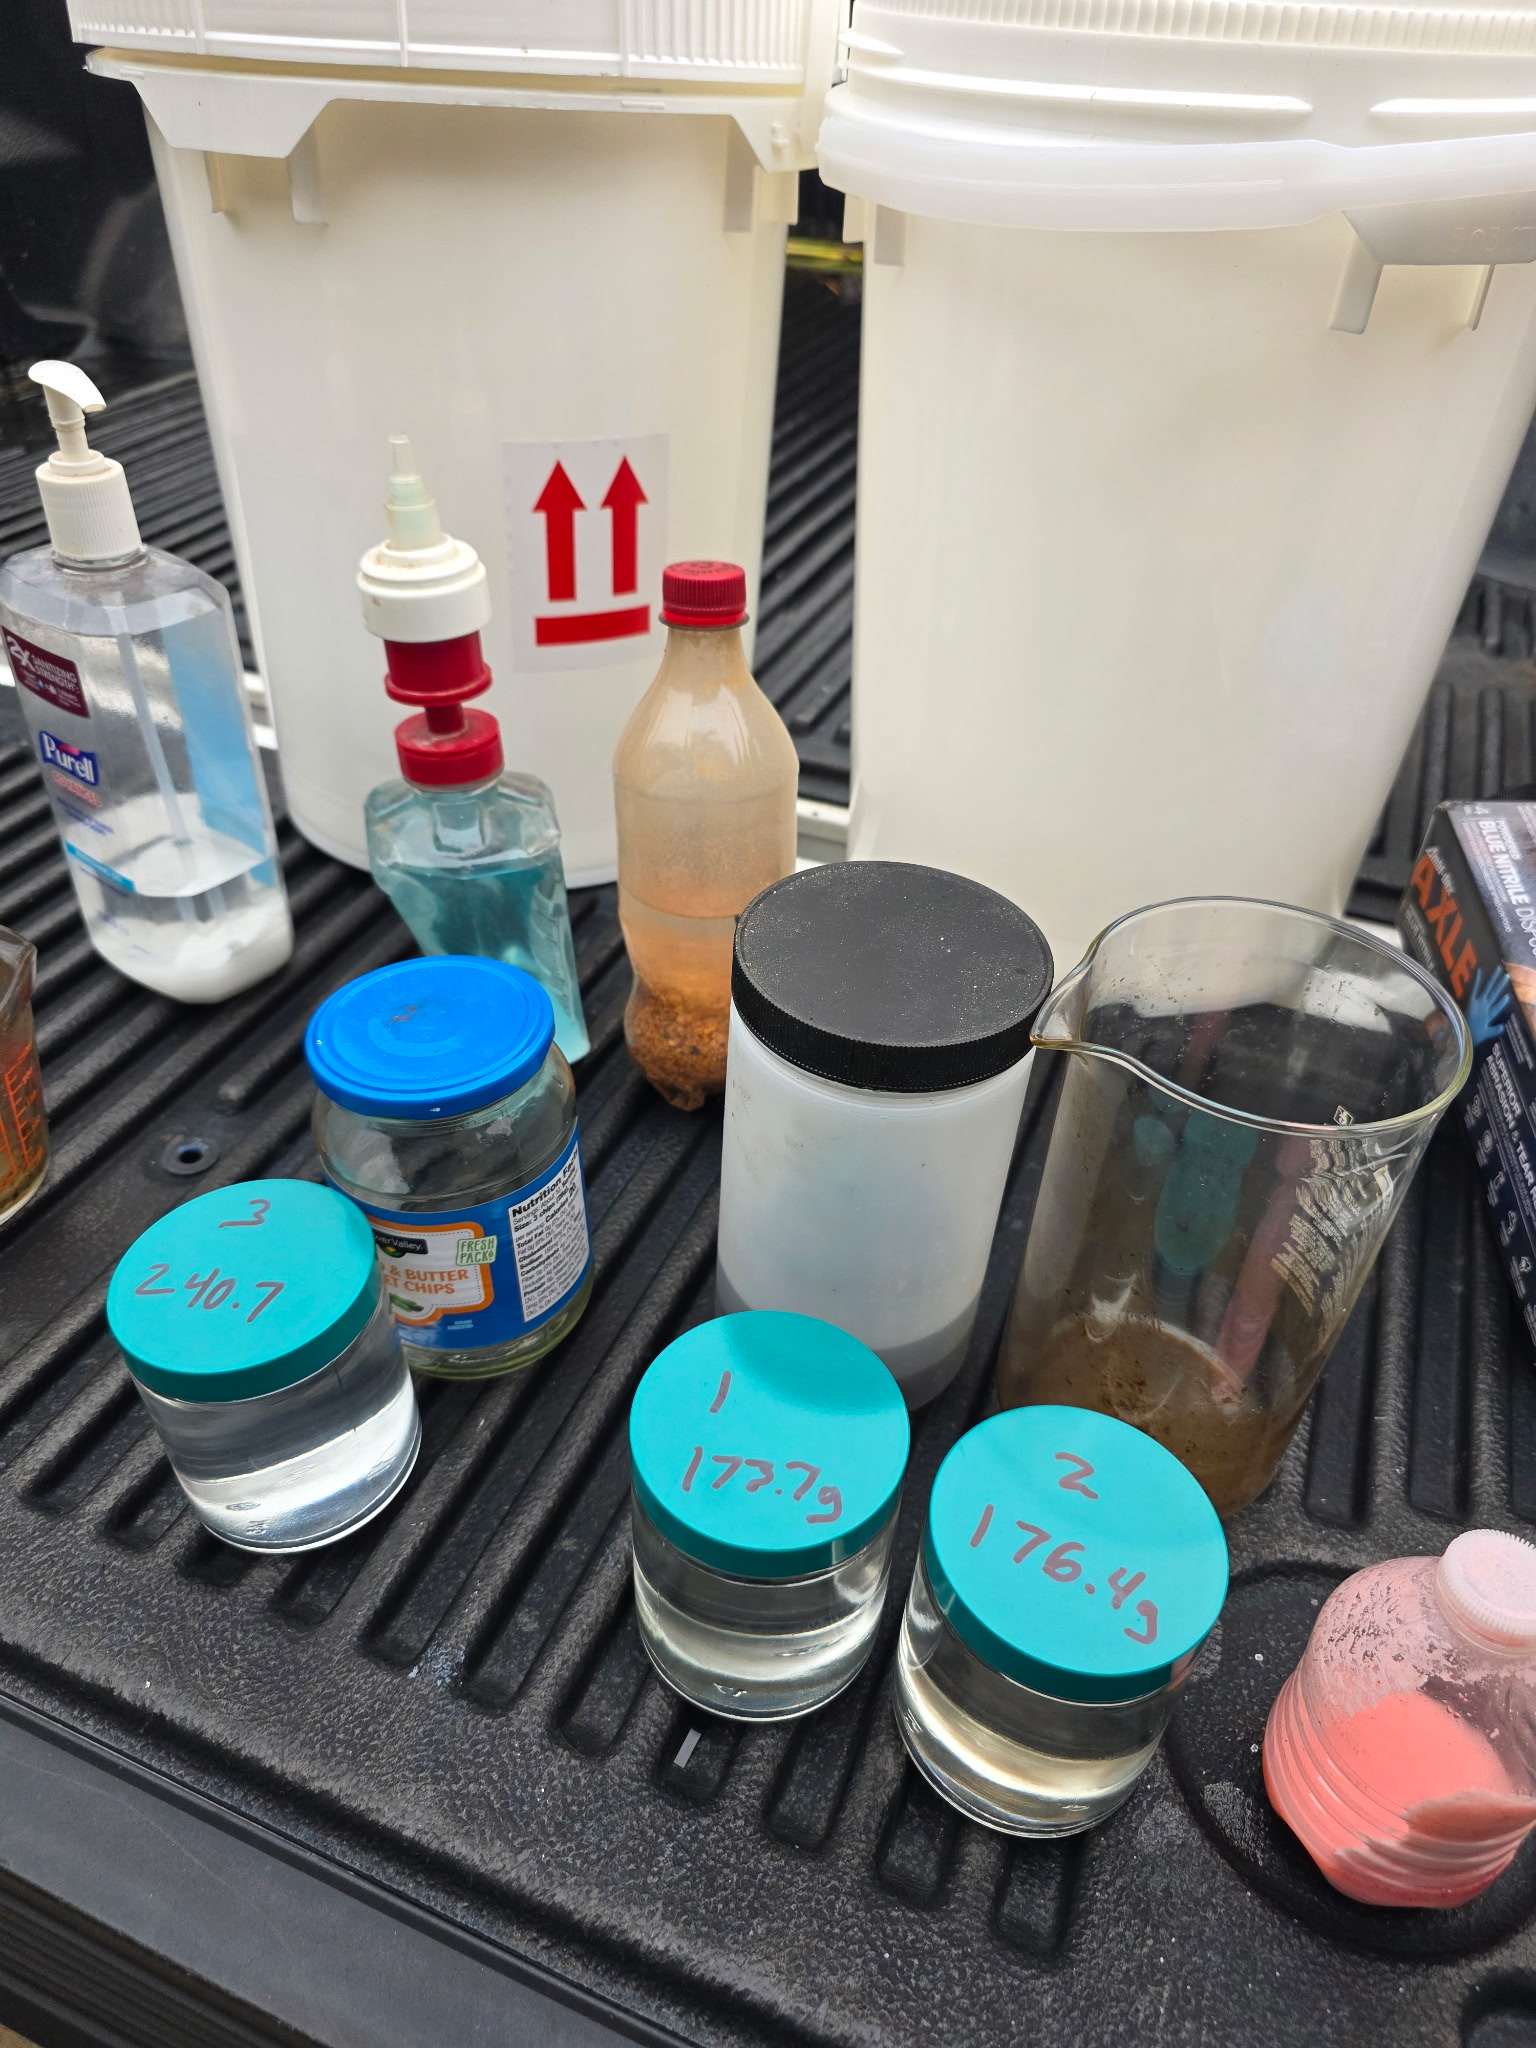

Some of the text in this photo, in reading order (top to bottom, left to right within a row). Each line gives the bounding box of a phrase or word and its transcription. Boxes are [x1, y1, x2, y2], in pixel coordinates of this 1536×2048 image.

[7, 635, 36, 672] 2X
[42, 732, 95, 783] Purell
[1478, 821, 1506, 853] BLUE
[1493, 853, 1530, 905] NITRILE
[1411, 854, 1477, 999] AXLE
[1492, 1043, 1521, 1117] SUPERIOR
[1486, 1055, 1515, 1129] ABRASION
[1516, 1141, 1534, 1187] TEAR
[218, 1198, 272, 1229] 3
[512, 1177, 562, 1218] Nutrition
[514, 1219, 532, 1232] Size:
[539, 1202, 555, 1217] chips
[545, 1198, 568, 1223] Calories
[460, 1237, 496, 1252] FRESH
[518, 1237, 553, 1263] Cholesterol
[534, 1229, 544, 1239] Fat
[389, 1264, 402, 1278] &
[404, 1268, 470, 1282] BUTTER
[460, 1250, 490, 1264] PACK
[134, 1262, 286, 1323] 240.7
[403, 1280, 456, 1295] CHIPS
[709, 1369, 732, 1414] 1
[681, 1445, 843, 1524] 173.7g
[1054, 1451, 1099, 1500] 2
[969, 1503, 1159, 1645] 176.4g
